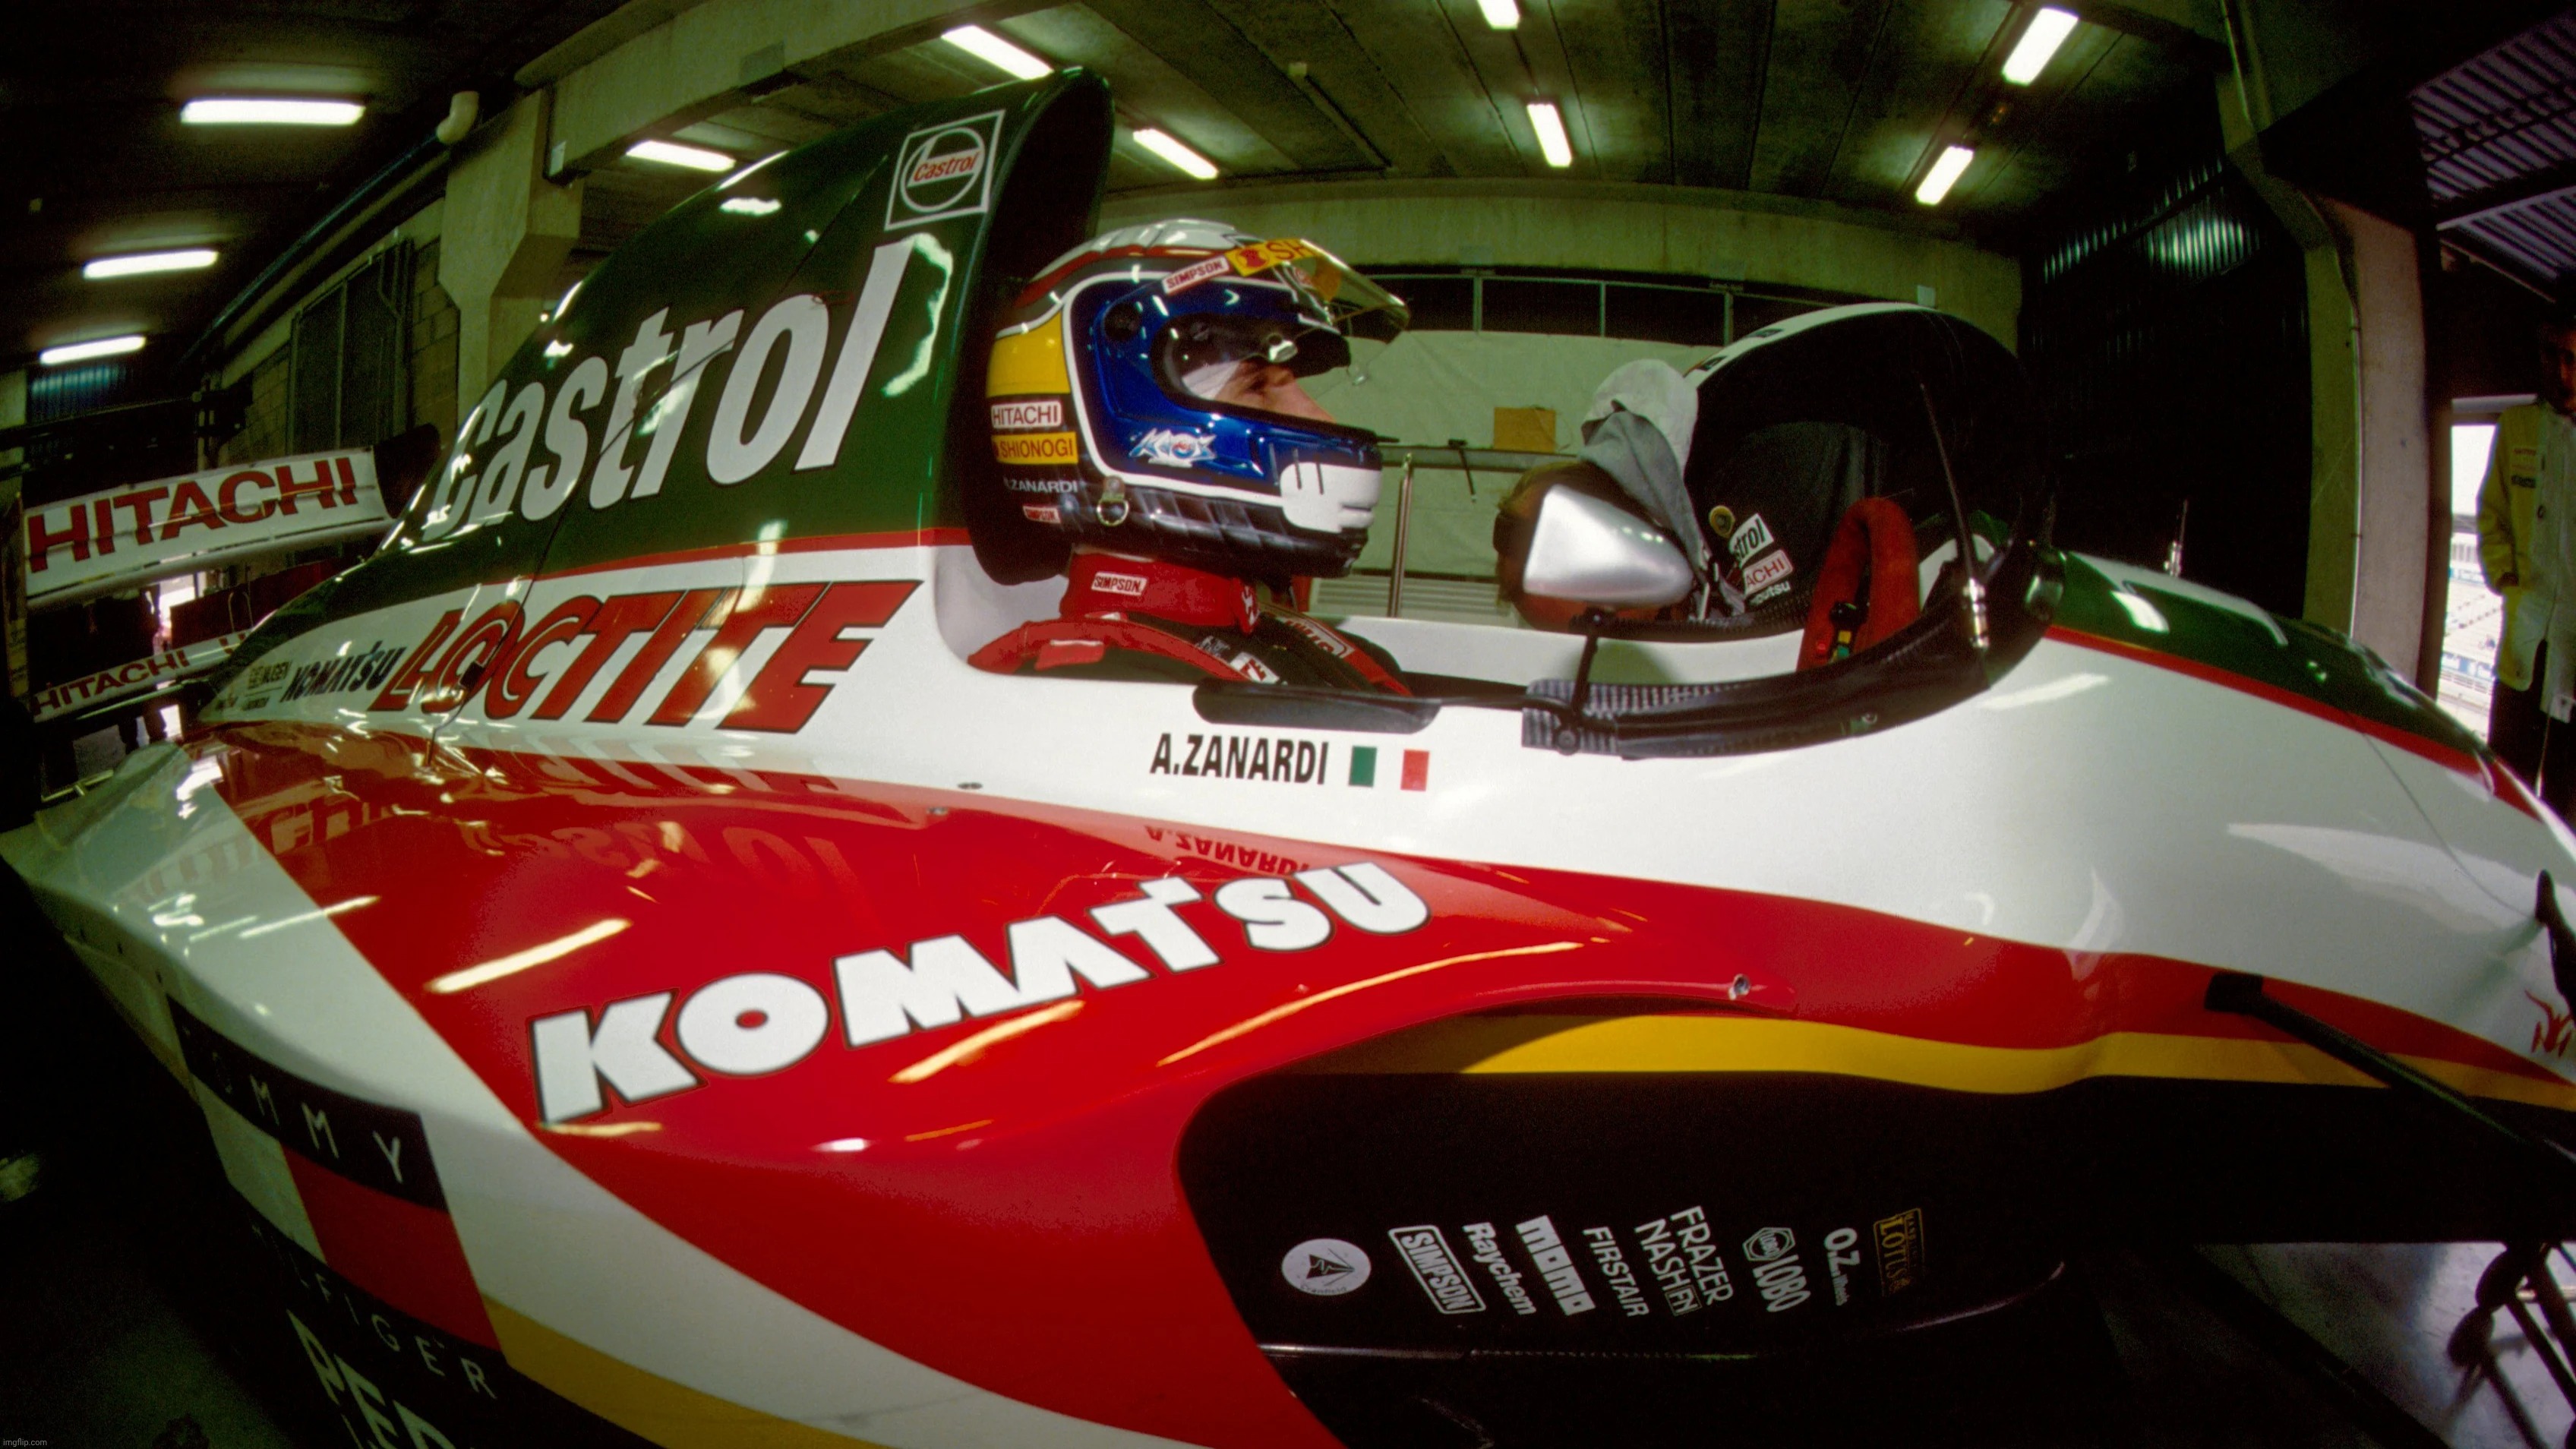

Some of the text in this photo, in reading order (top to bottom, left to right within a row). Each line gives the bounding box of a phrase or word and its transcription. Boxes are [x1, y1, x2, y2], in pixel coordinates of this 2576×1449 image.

[914, 150, 980, 182] Castrol
[1165, 260, 1223, 289] SIMPSON
[421, 237, 914, 541] Castrol
[993, 405, 1059, 427] HITACHI
[1000, 439, 1073, 458] SHIONOGI
[27, 457, 358, 574] HITACHI
[1094, 576, 1141, 592] SIMPSON
[30, 650, 190, 716] HITACHI
[279, 640, 407, 703] KOMATSU
[366, 579, 925, 734] LOCTITE
[1150, 732, 1330, 785] A.ZANARDI
[532, 862, 1431, 1125] KOMATSU
[1400, 1231, 1474, 1312] SIMPSON
[1462, 1221, 1537, 1315] Raychem
[1583, 1226, 1649, 1318] FIRSTAIR
[1634, 1218, 1691, 1290] NASH
[1670, 1205, 1734, 1307] FRAZER
[1752, 1254, 1811, 1313] LOBO
